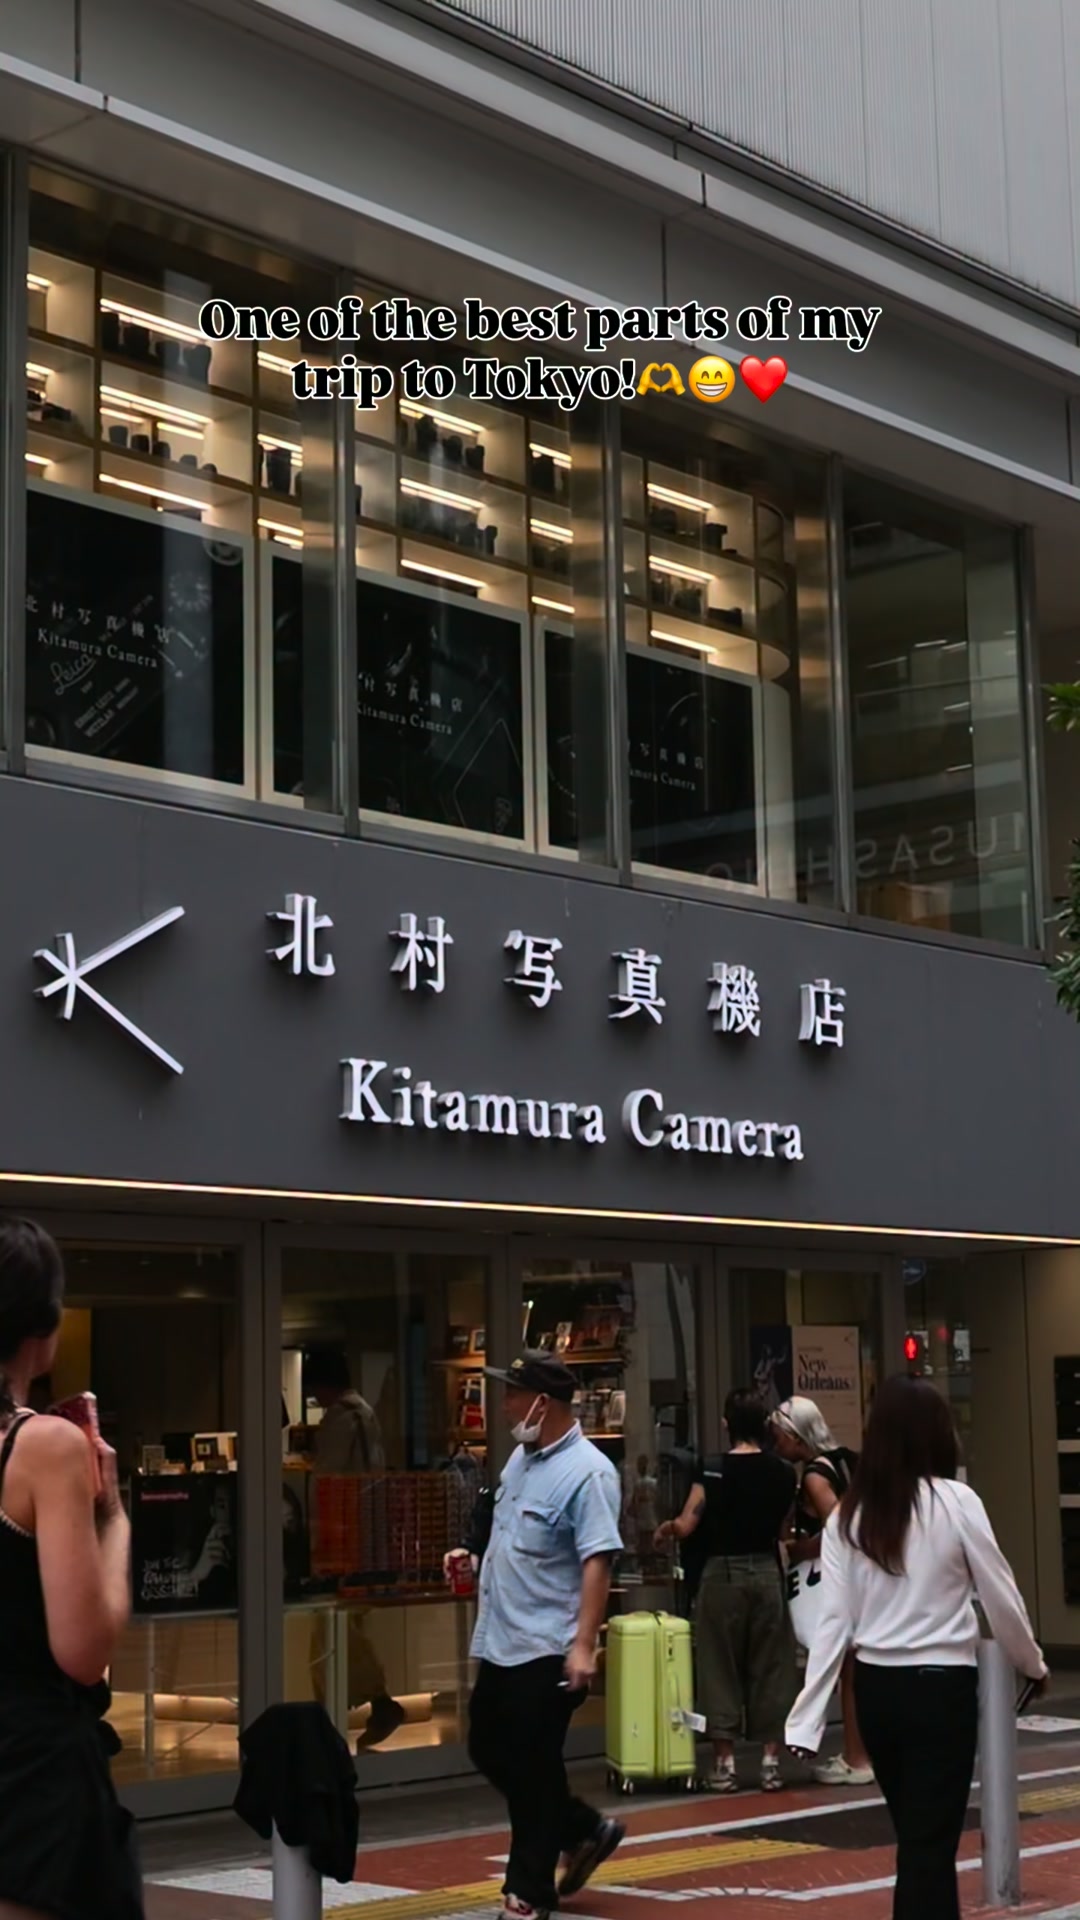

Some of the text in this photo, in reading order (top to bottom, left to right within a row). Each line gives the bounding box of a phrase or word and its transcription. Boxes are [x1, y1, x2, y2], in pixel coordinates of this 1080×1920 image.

[37, 628, 158, 668] Kitamura Camera
[409, 713, 453, 735] Camera
[267, 893, 845, 1047] 北村写真機店
[339, 1057, 804, 1161] Kitamura Camera
[798, 1353, 828, 1372] New
[797, 1371, 850, 1391] Orleans
